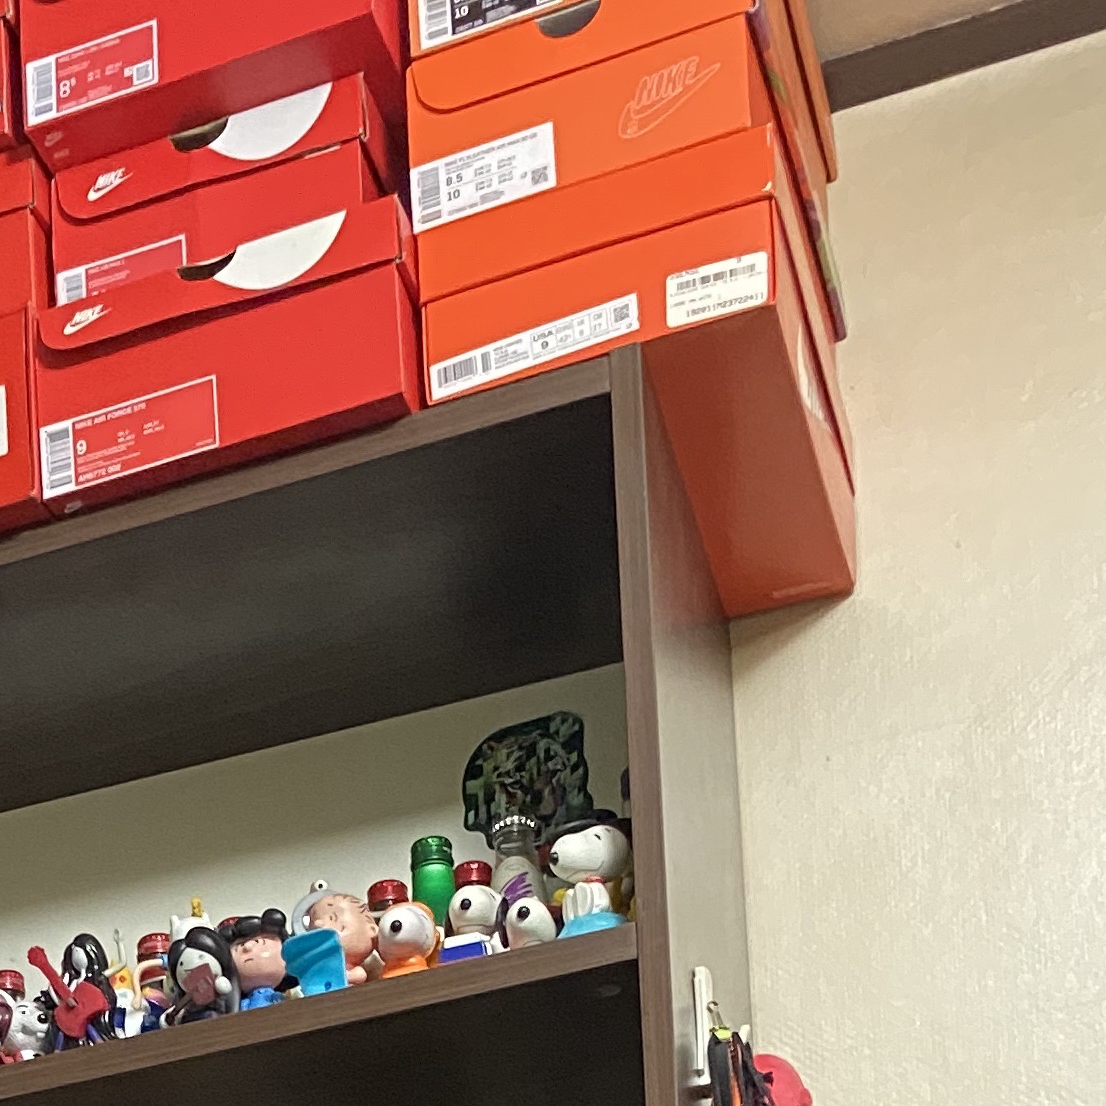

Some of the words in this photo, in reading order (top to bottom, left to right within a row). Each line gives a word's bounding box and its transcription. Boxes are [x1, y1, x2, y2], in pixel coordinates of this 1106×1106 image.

[454, 5, 469, 20] 10
[447, 189, 460, 202] 10
[76, 438, 86, 456] 9
